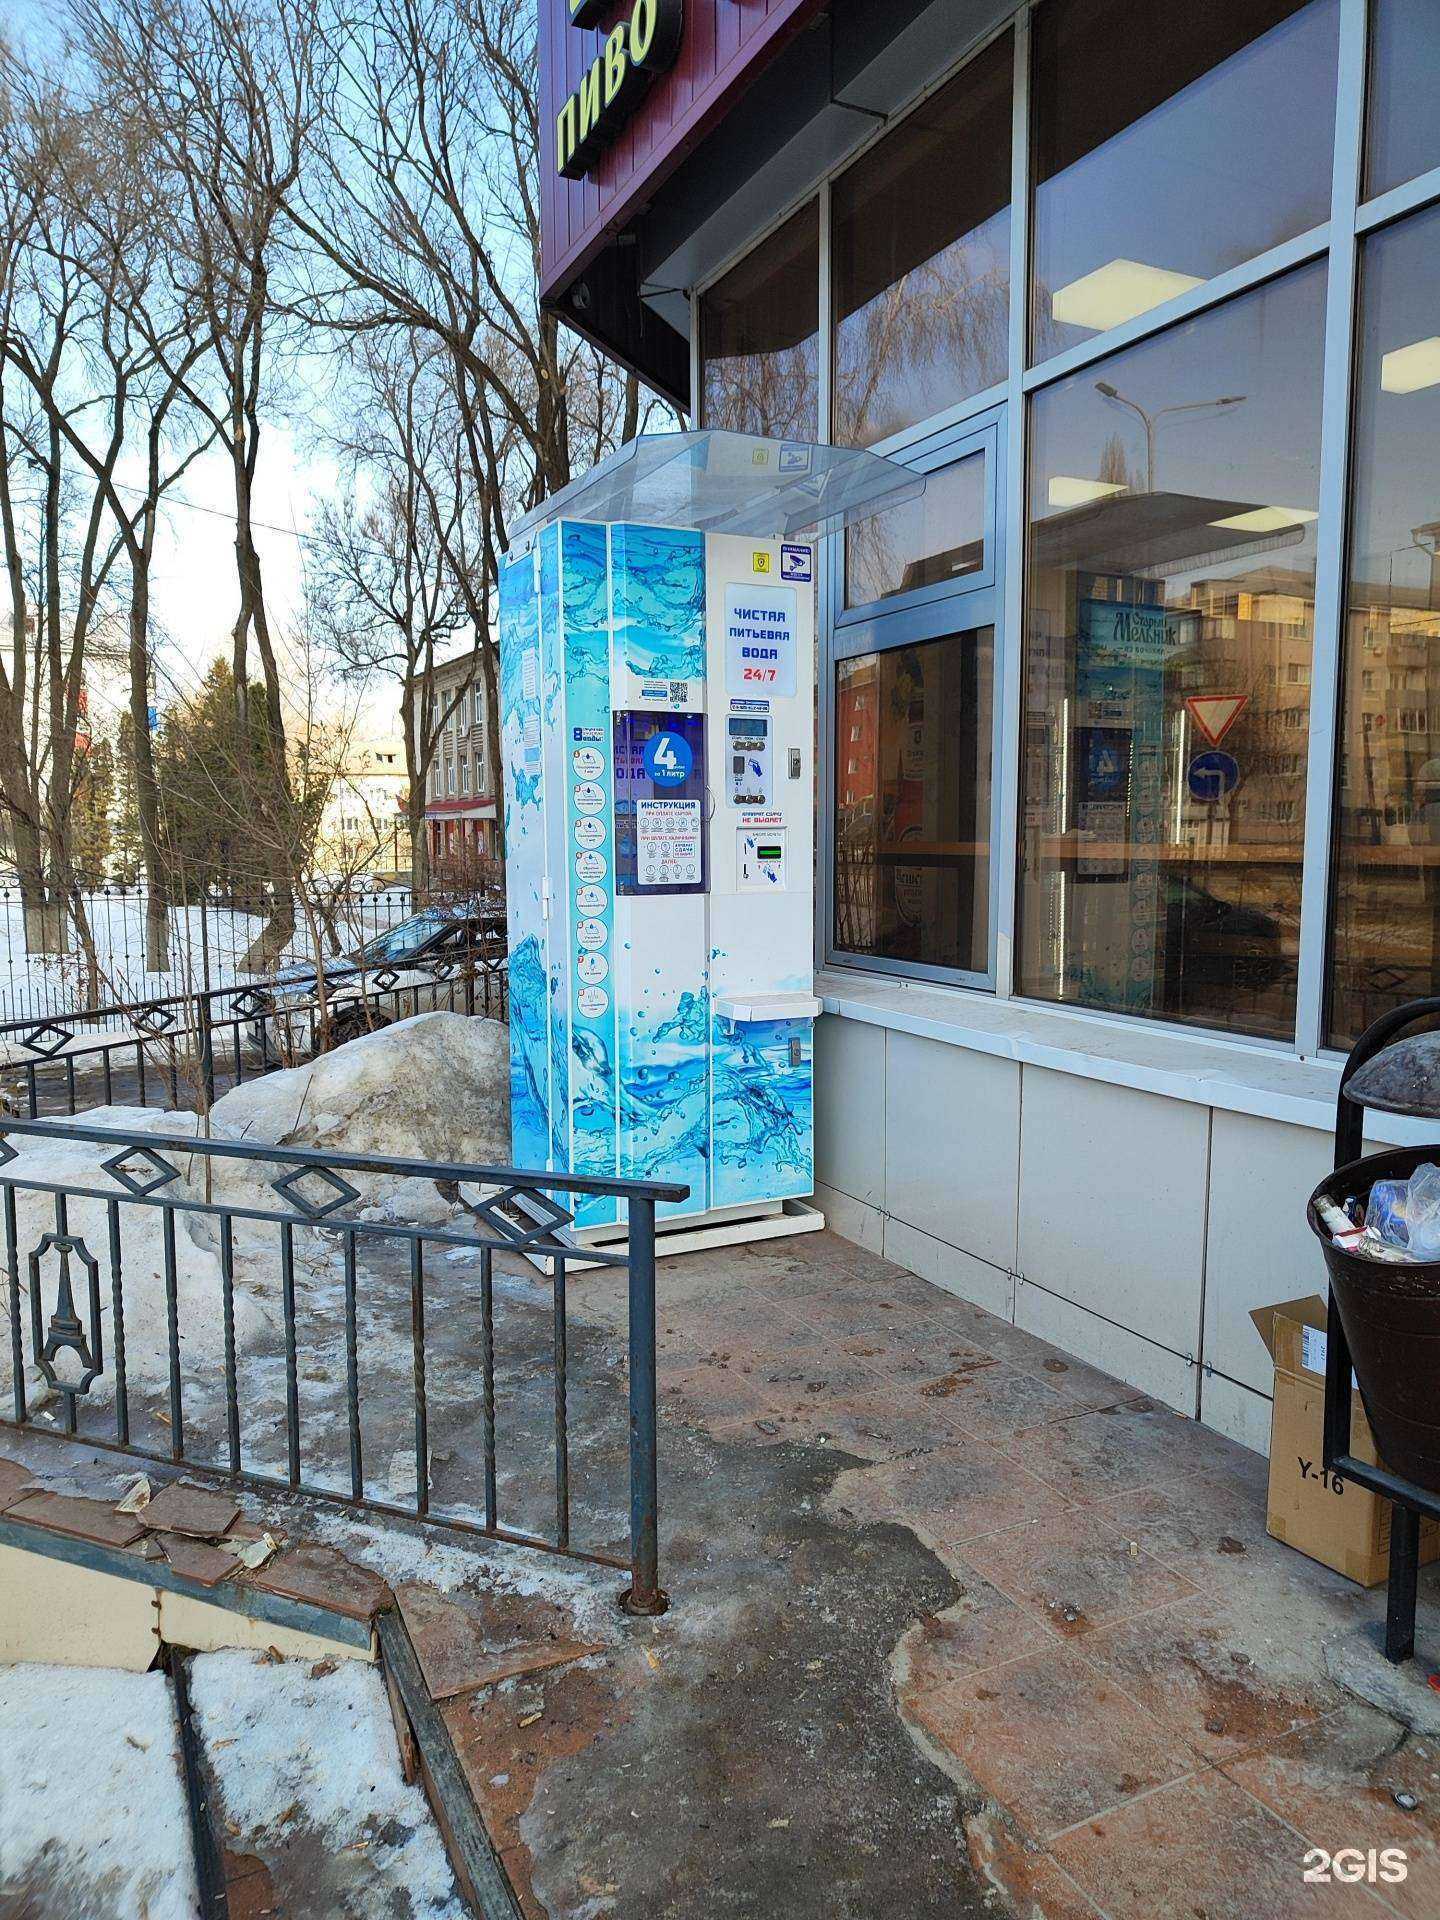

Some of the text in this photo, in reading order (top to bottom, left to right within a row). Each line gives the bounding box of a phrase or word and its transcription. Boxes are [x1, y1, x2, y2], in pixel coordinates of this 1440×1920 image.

[556, 0, 662, 176] ПИВО
[734, 607, 786, 623] ЧИСТАЯ
[729, 627, 790, 641] ПИТЬЕВАЯ
[741, 646, 778, 660] ВОДА
[743, 668, 777, 682] 24/7
[653, 737, 677, 770] 4
[666, 771, 685, 779] литр
[641, 801, 696, 810] ИНСТРУКЦИЯ
[1297, 1456, 1345, 1496] Y-16
